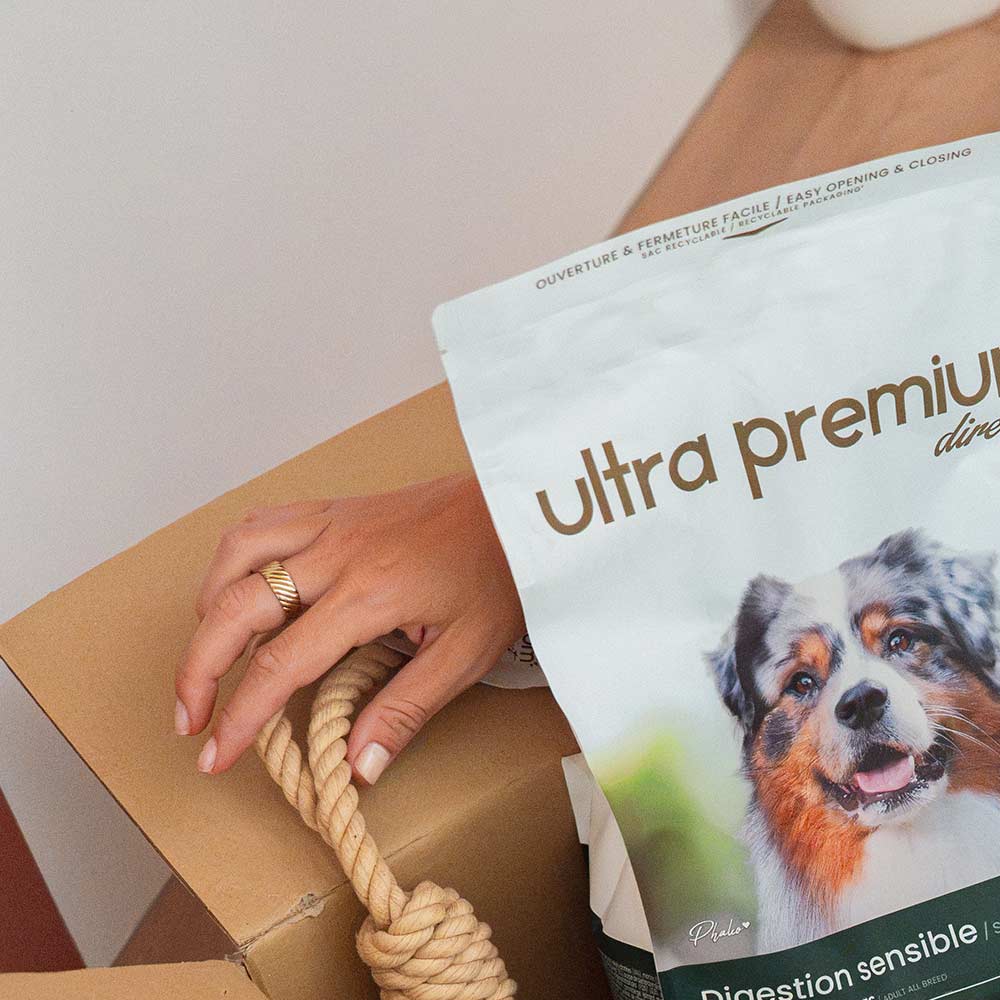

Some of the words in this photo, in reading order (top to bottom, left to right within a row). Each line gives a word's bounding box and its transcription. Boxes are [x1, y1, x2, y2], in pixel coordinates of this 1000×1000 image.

[535, 250, 618, 290] OUVERTURE
[623, 245, 633, 256] &
[638, 217, 718, 250] FERMETURE
[723, 200, 770, 224] FACILE
[775, 195, 781, 209] /
[787, 187, 821, 205] EASY
[826, 168, 889, 192] OPENING
[894, 164, 904, 174] &
[909, 148, 972, 170] CLOSING
[641, 248, 661, 259] SAC
[665, 225, 726, 251] RECYCLABLE
[739, 204, 799, 227] RECYCLABLE
[535, 433, 717, 537] ultra
[857, 923, 978, 981] sensible
[984, 921, 989, 940] /
[907, 983, 921, 995] ALL
[922, 974, 948, 989] BREED
